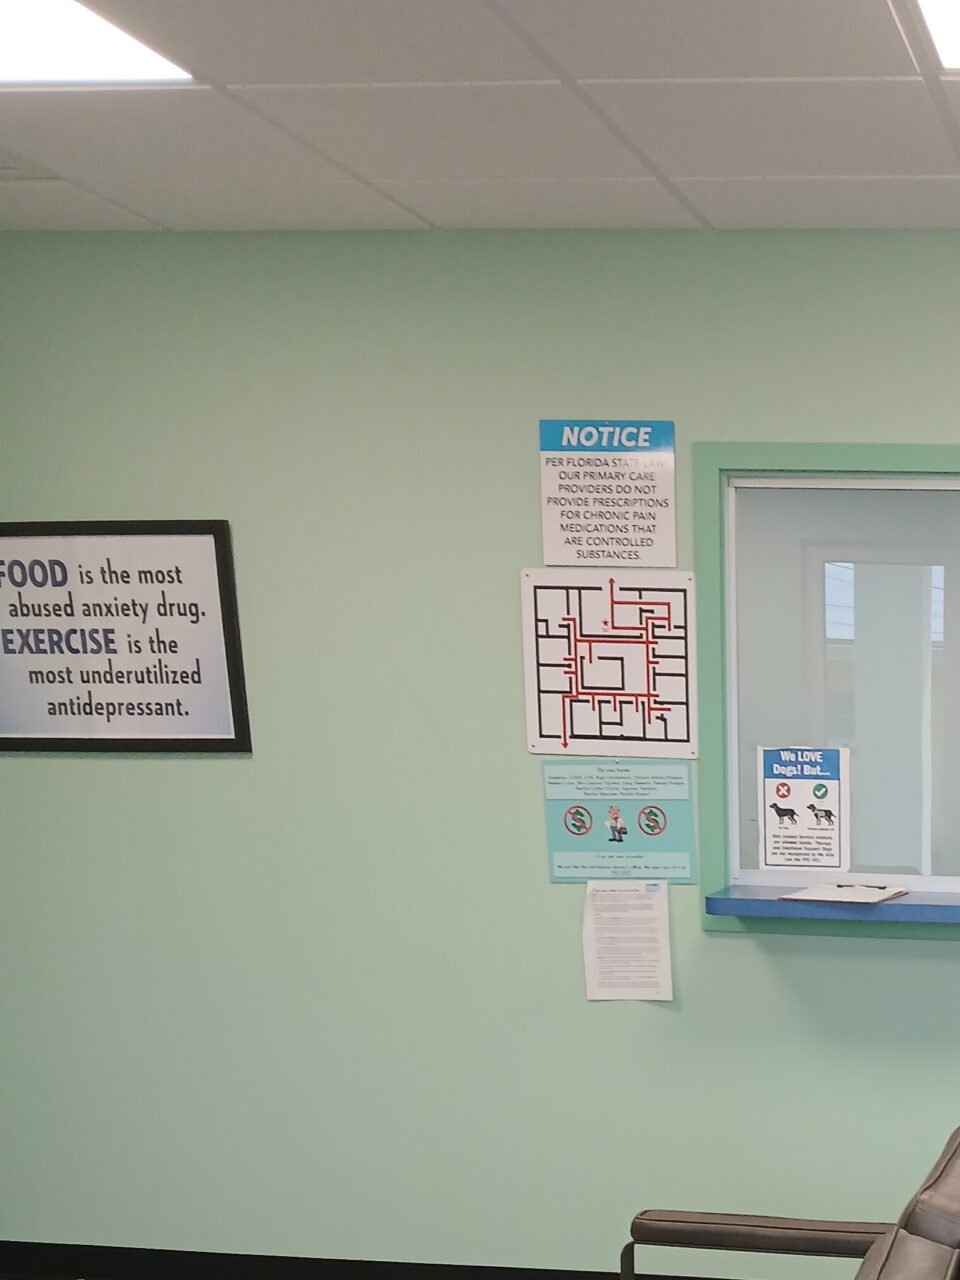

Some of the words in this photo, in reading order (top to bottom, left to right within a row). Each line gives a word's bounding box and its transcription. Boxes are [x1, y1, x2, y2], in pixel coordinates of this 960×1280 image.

[561, 426, 652, 447] NOTICE
[545, 458, 564, 468] PER
[566, 458, 610, 468] FLORIDA
[559, 471, 580, 481] OUR
[583, 471, 626, 481] PRIMARY
[629, 471, 655, 481] CARE
[558, 484, 613, 494] PROVIDERS
[616, 484, 632, 494] DO
[634, 484, 656, 494] NOT
[547, 497, 589, 506] PROVIDE
[592, 498, 669, 508] PRESCRIPTIONS
[560, 511, 580, 520] FOR
[584, 511, 630, 520] CHRONIC
[633, 511, 656, 520] PAIN
[560, 524, 629, 534] MEDICATIONS
[632, 524, 656, 534] THAT
[564, 537, 583, 547] ARE
[586, 537, 654, 547] CONTROLLED
[576, 550, 641, 560] SUBSTANCES.
[0, 560, 68, 588] FOOD
[78, 565, 94, 584] is
[100, 558, 130, 584] the
[138, 566, 183, 584] most
[9, 591, 75, 618] abused
[82, 597, 149, 624] anxiety
[157, 590, 206, 624] drug.
[1, 628, 118, 654] EXERCISE
[127, 634, 142, 654] is
[149, 628, 178, 654] the
[29, 666, 74, 684] most
[80, 658, 202, 684] underutilized
[48, 690, 189, 722] antidepressant.
[780, 751, 796, 762] We
[798, 751, 823, 762] LOVE
[773, 764, 800, 777] Dogs!
